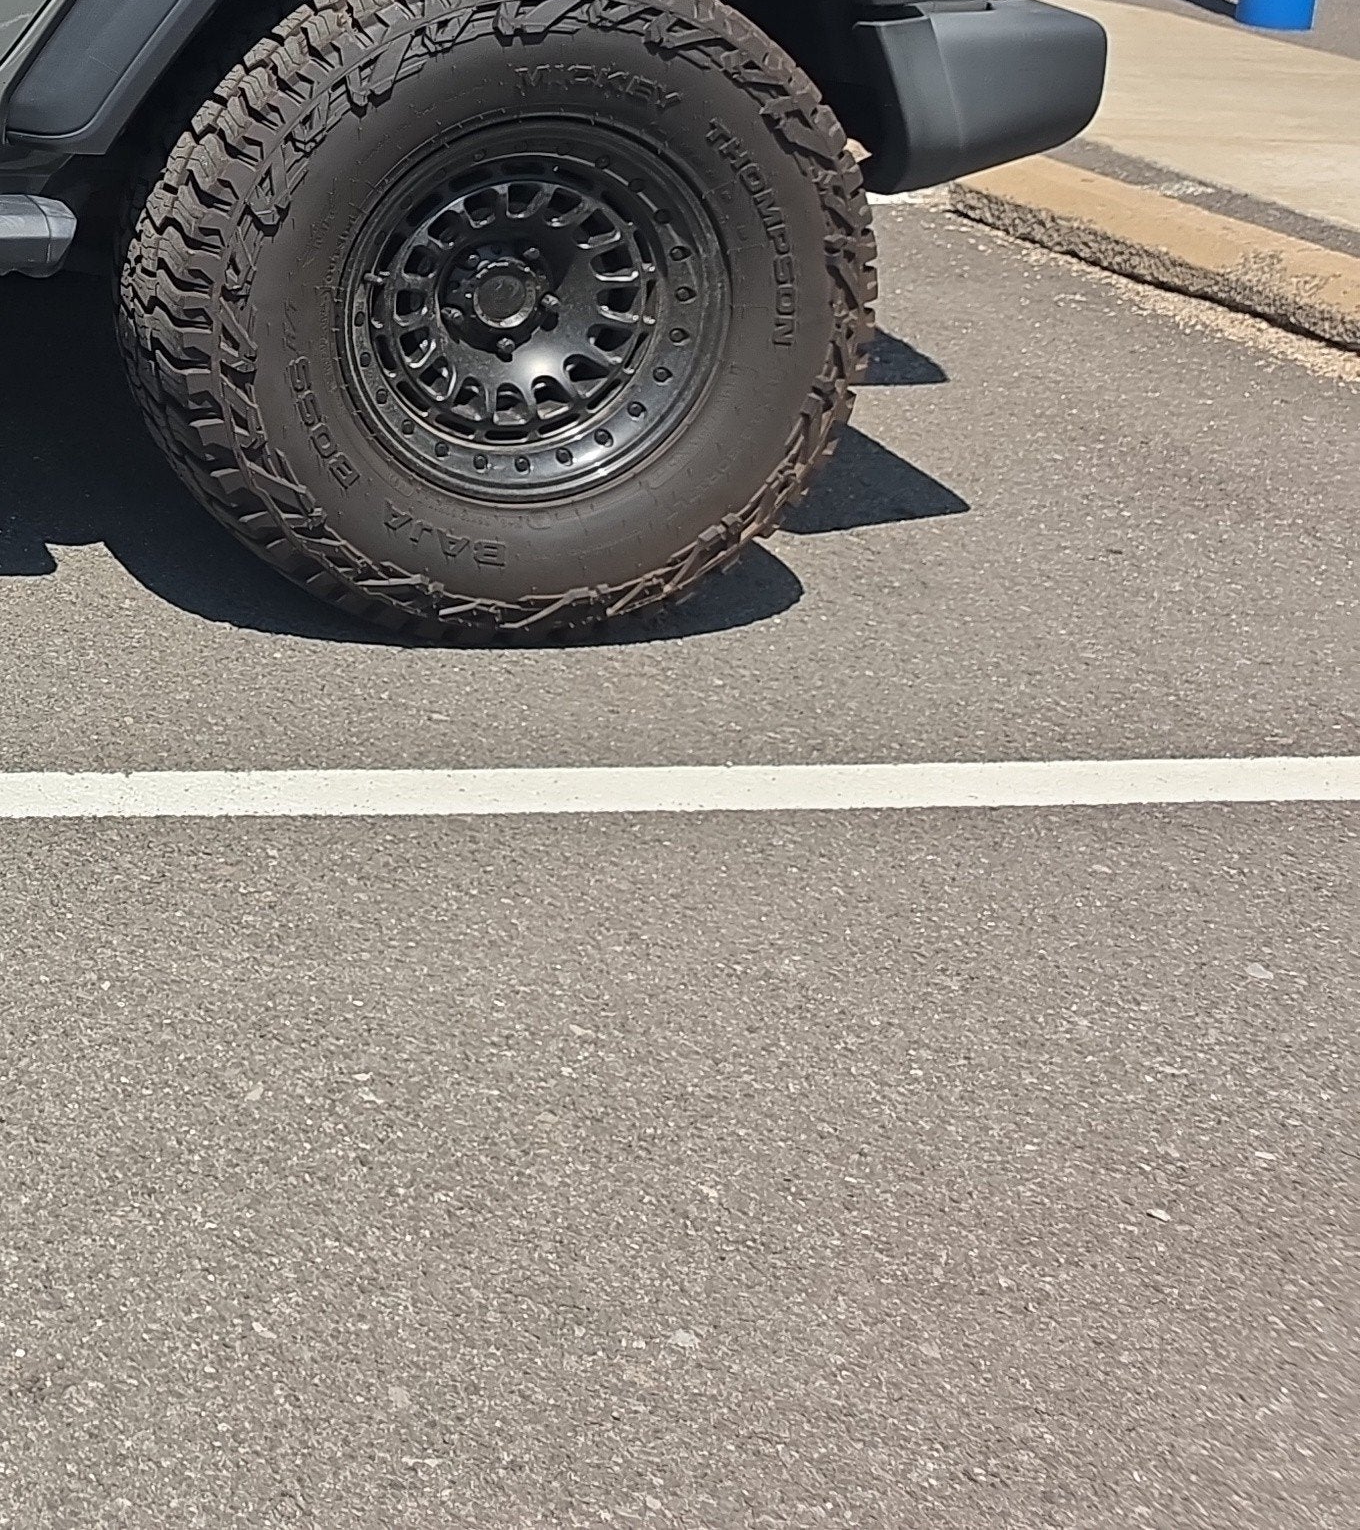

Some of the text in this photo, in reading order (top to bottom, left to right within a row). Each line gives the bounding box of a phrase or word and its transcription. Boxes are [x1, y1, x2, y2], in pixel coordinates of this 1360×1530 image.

[512, 62, 797, 349] MICKEY THOMPSON
[283, 355, 362, 490] BOSS
[384, 498, 508, 569] BAJA
